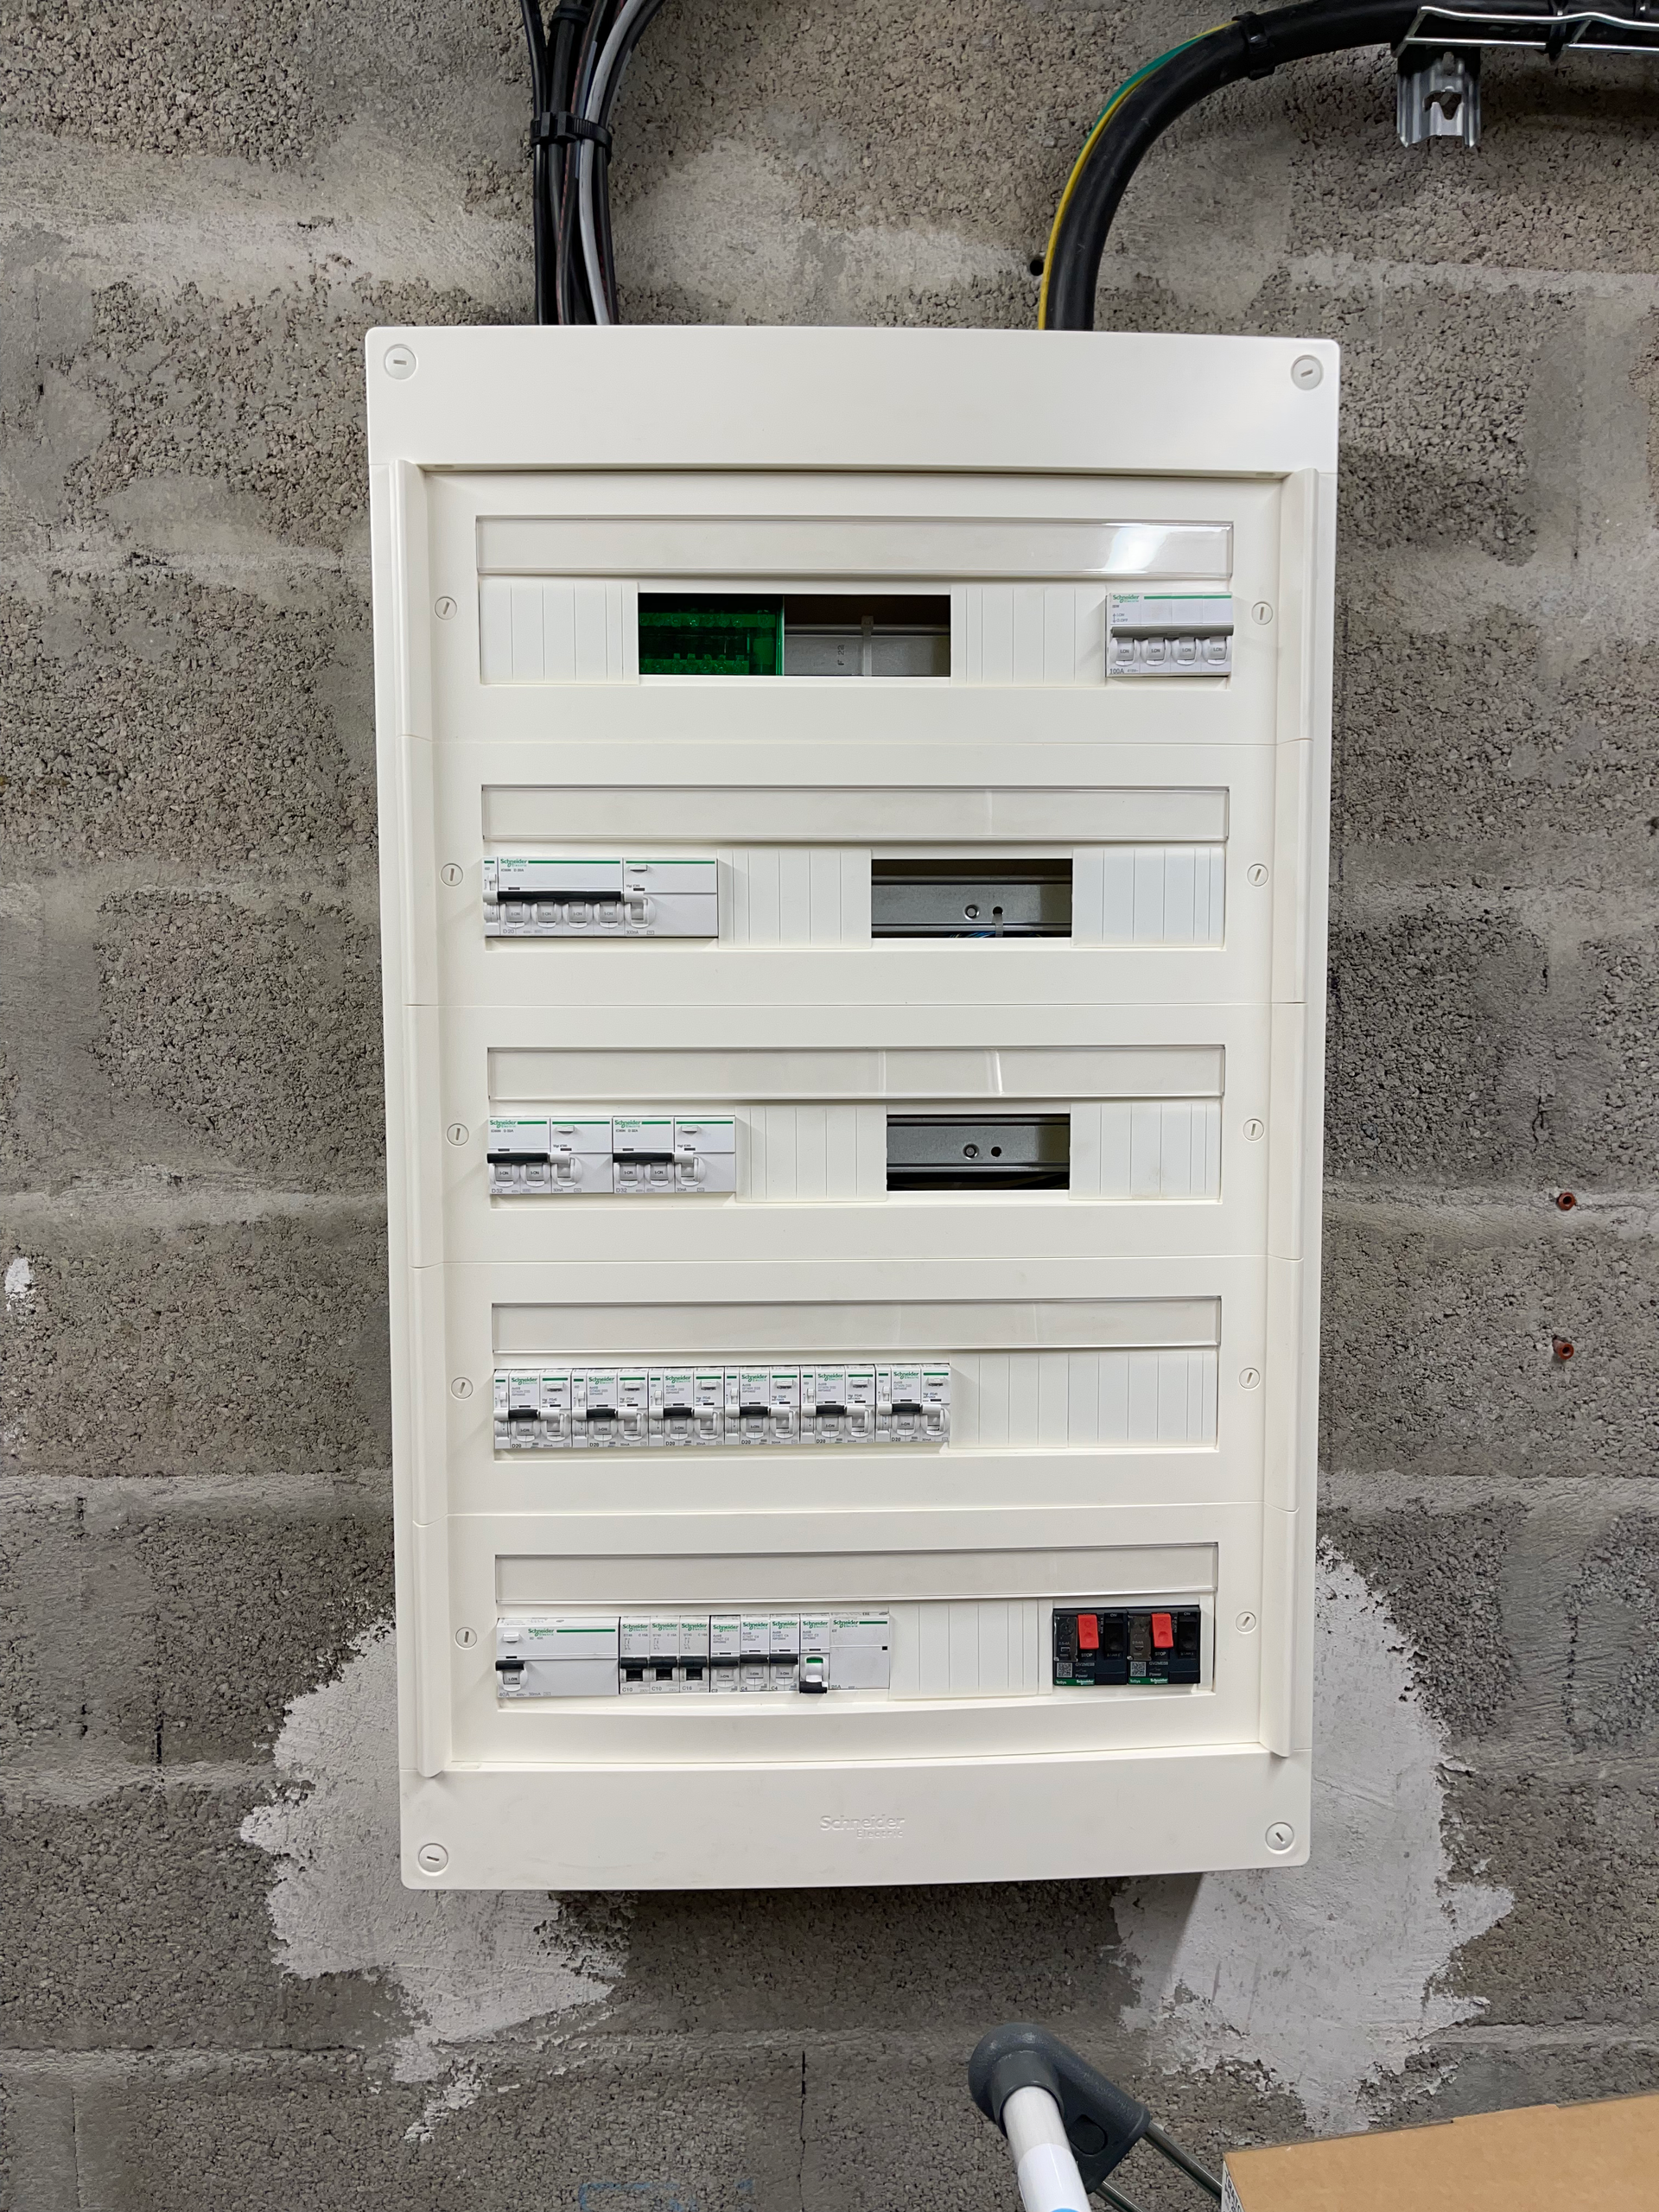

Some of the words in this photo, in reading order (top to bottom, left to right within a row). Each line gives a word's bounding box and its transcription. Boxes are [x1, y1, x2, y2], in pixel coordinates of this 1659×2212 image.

[1112, 594, 1139, 603] Schneider
[500, 859, 527, 868] Schneider
[489, 1120, 517, 1128] Schneider
[614, 1120, 641, 1128] Schneider
[511, 1377, 538, 1385] Schneider
[665, 1376, 691, 1384] Schneider
[623, 1624, 648, 1632] Schneider
[652, 1623, 678, 1631] Schneider
[682, 1623, 707, 1632] Schneider
[743, 1622, 769, 1630] Schneider
[803, 1621, 828, 1629] Schneider
[833, 1620, 859, 1628] Schneider
[528, 1628, 554, 1637] Schneider
[713, 1625, 739, 1633] Schneider
